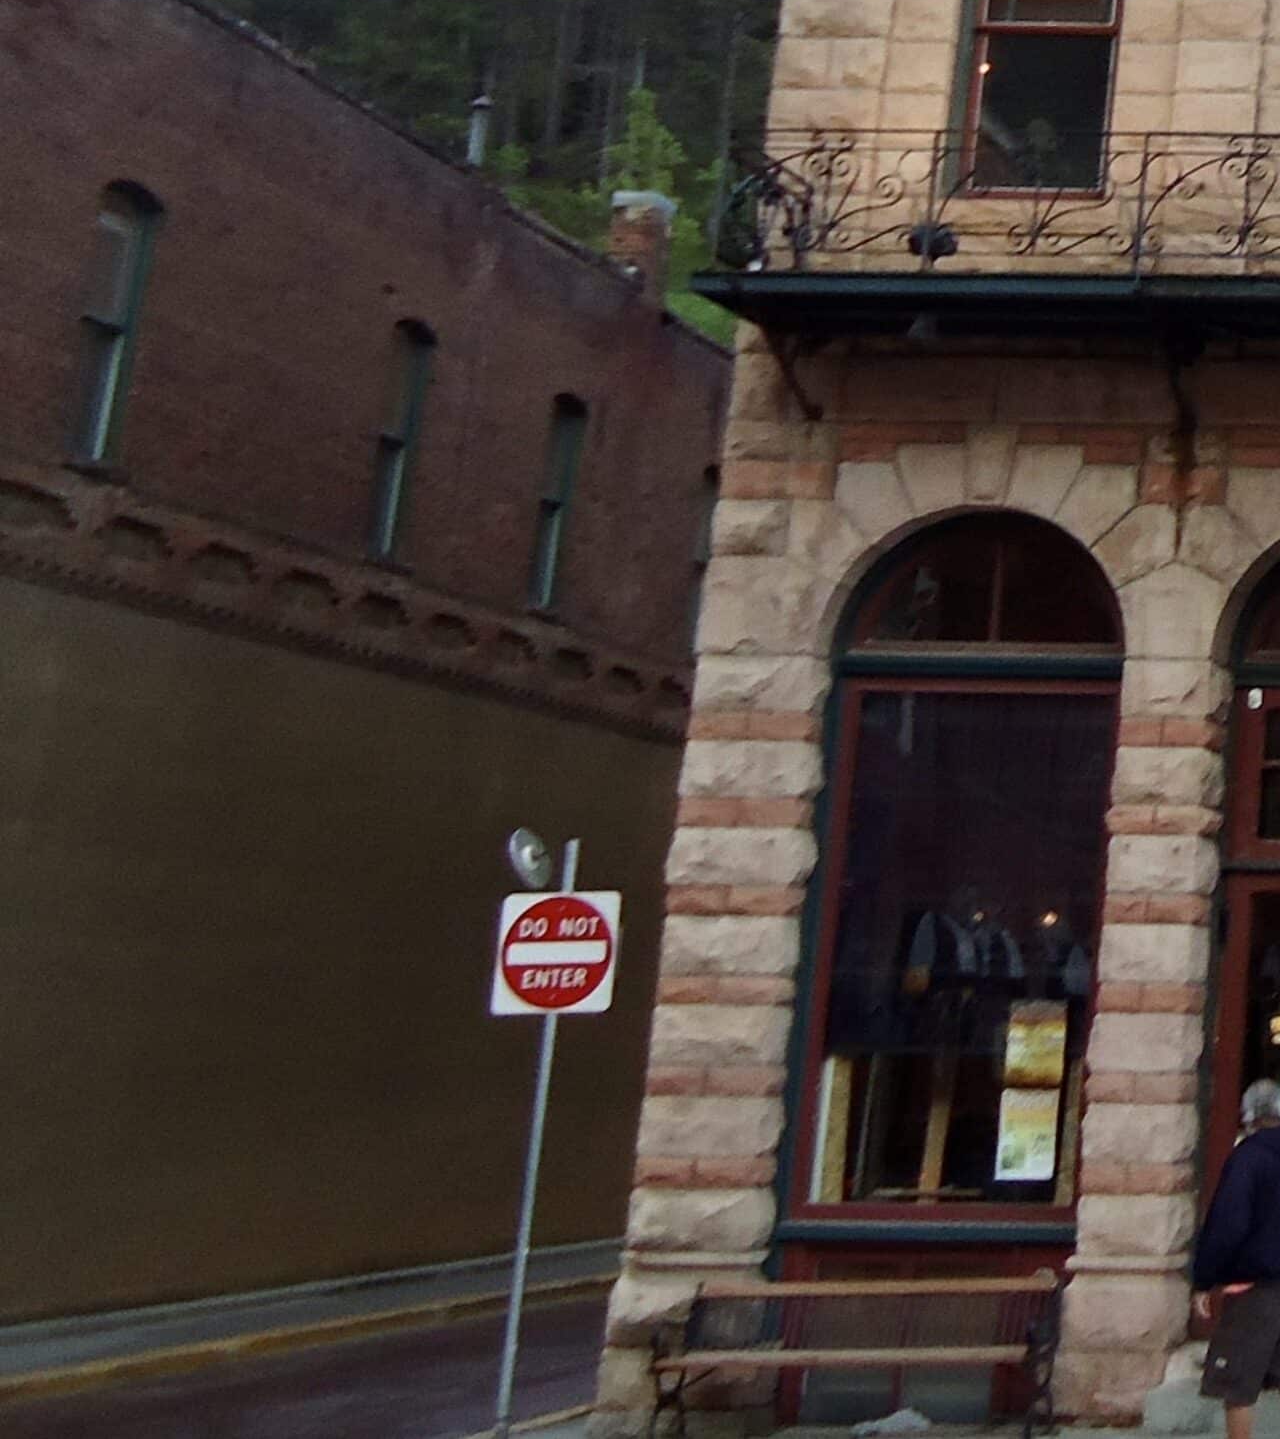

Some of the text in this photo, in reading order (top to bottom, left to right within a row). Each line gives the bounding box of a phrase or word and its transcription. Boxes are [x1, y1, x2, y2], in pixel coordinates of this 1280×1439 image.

[518, 915, 600, 939] DO NOT
[520, 967, 589, 990] ENTER
